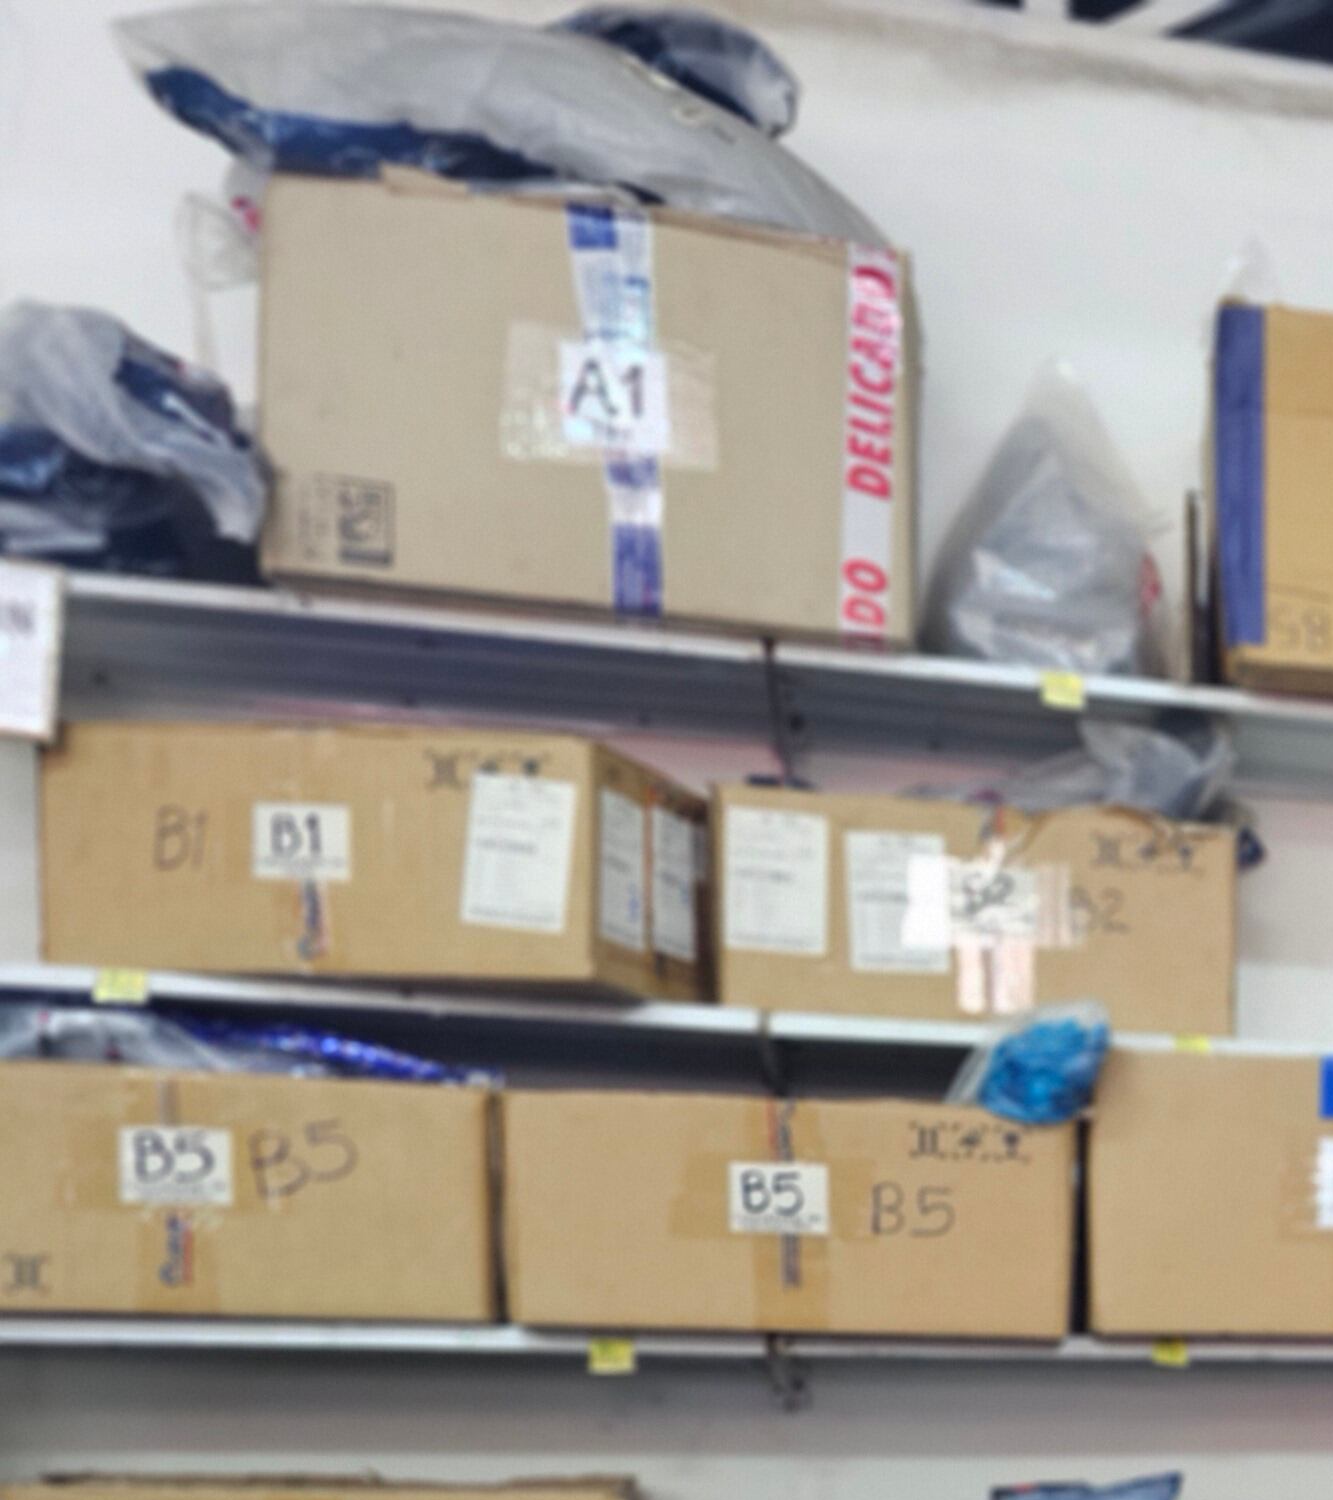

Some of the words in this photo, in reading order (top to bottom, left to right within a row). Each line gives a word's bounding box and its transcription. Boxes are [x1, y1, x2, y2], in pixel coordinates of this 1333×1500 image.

[567, 357, 647, 418] A1
[271, 813, 322, 856] B1
[740, 1168, 804, 1216] B5
[869, 1181, 956, 1237] B5
